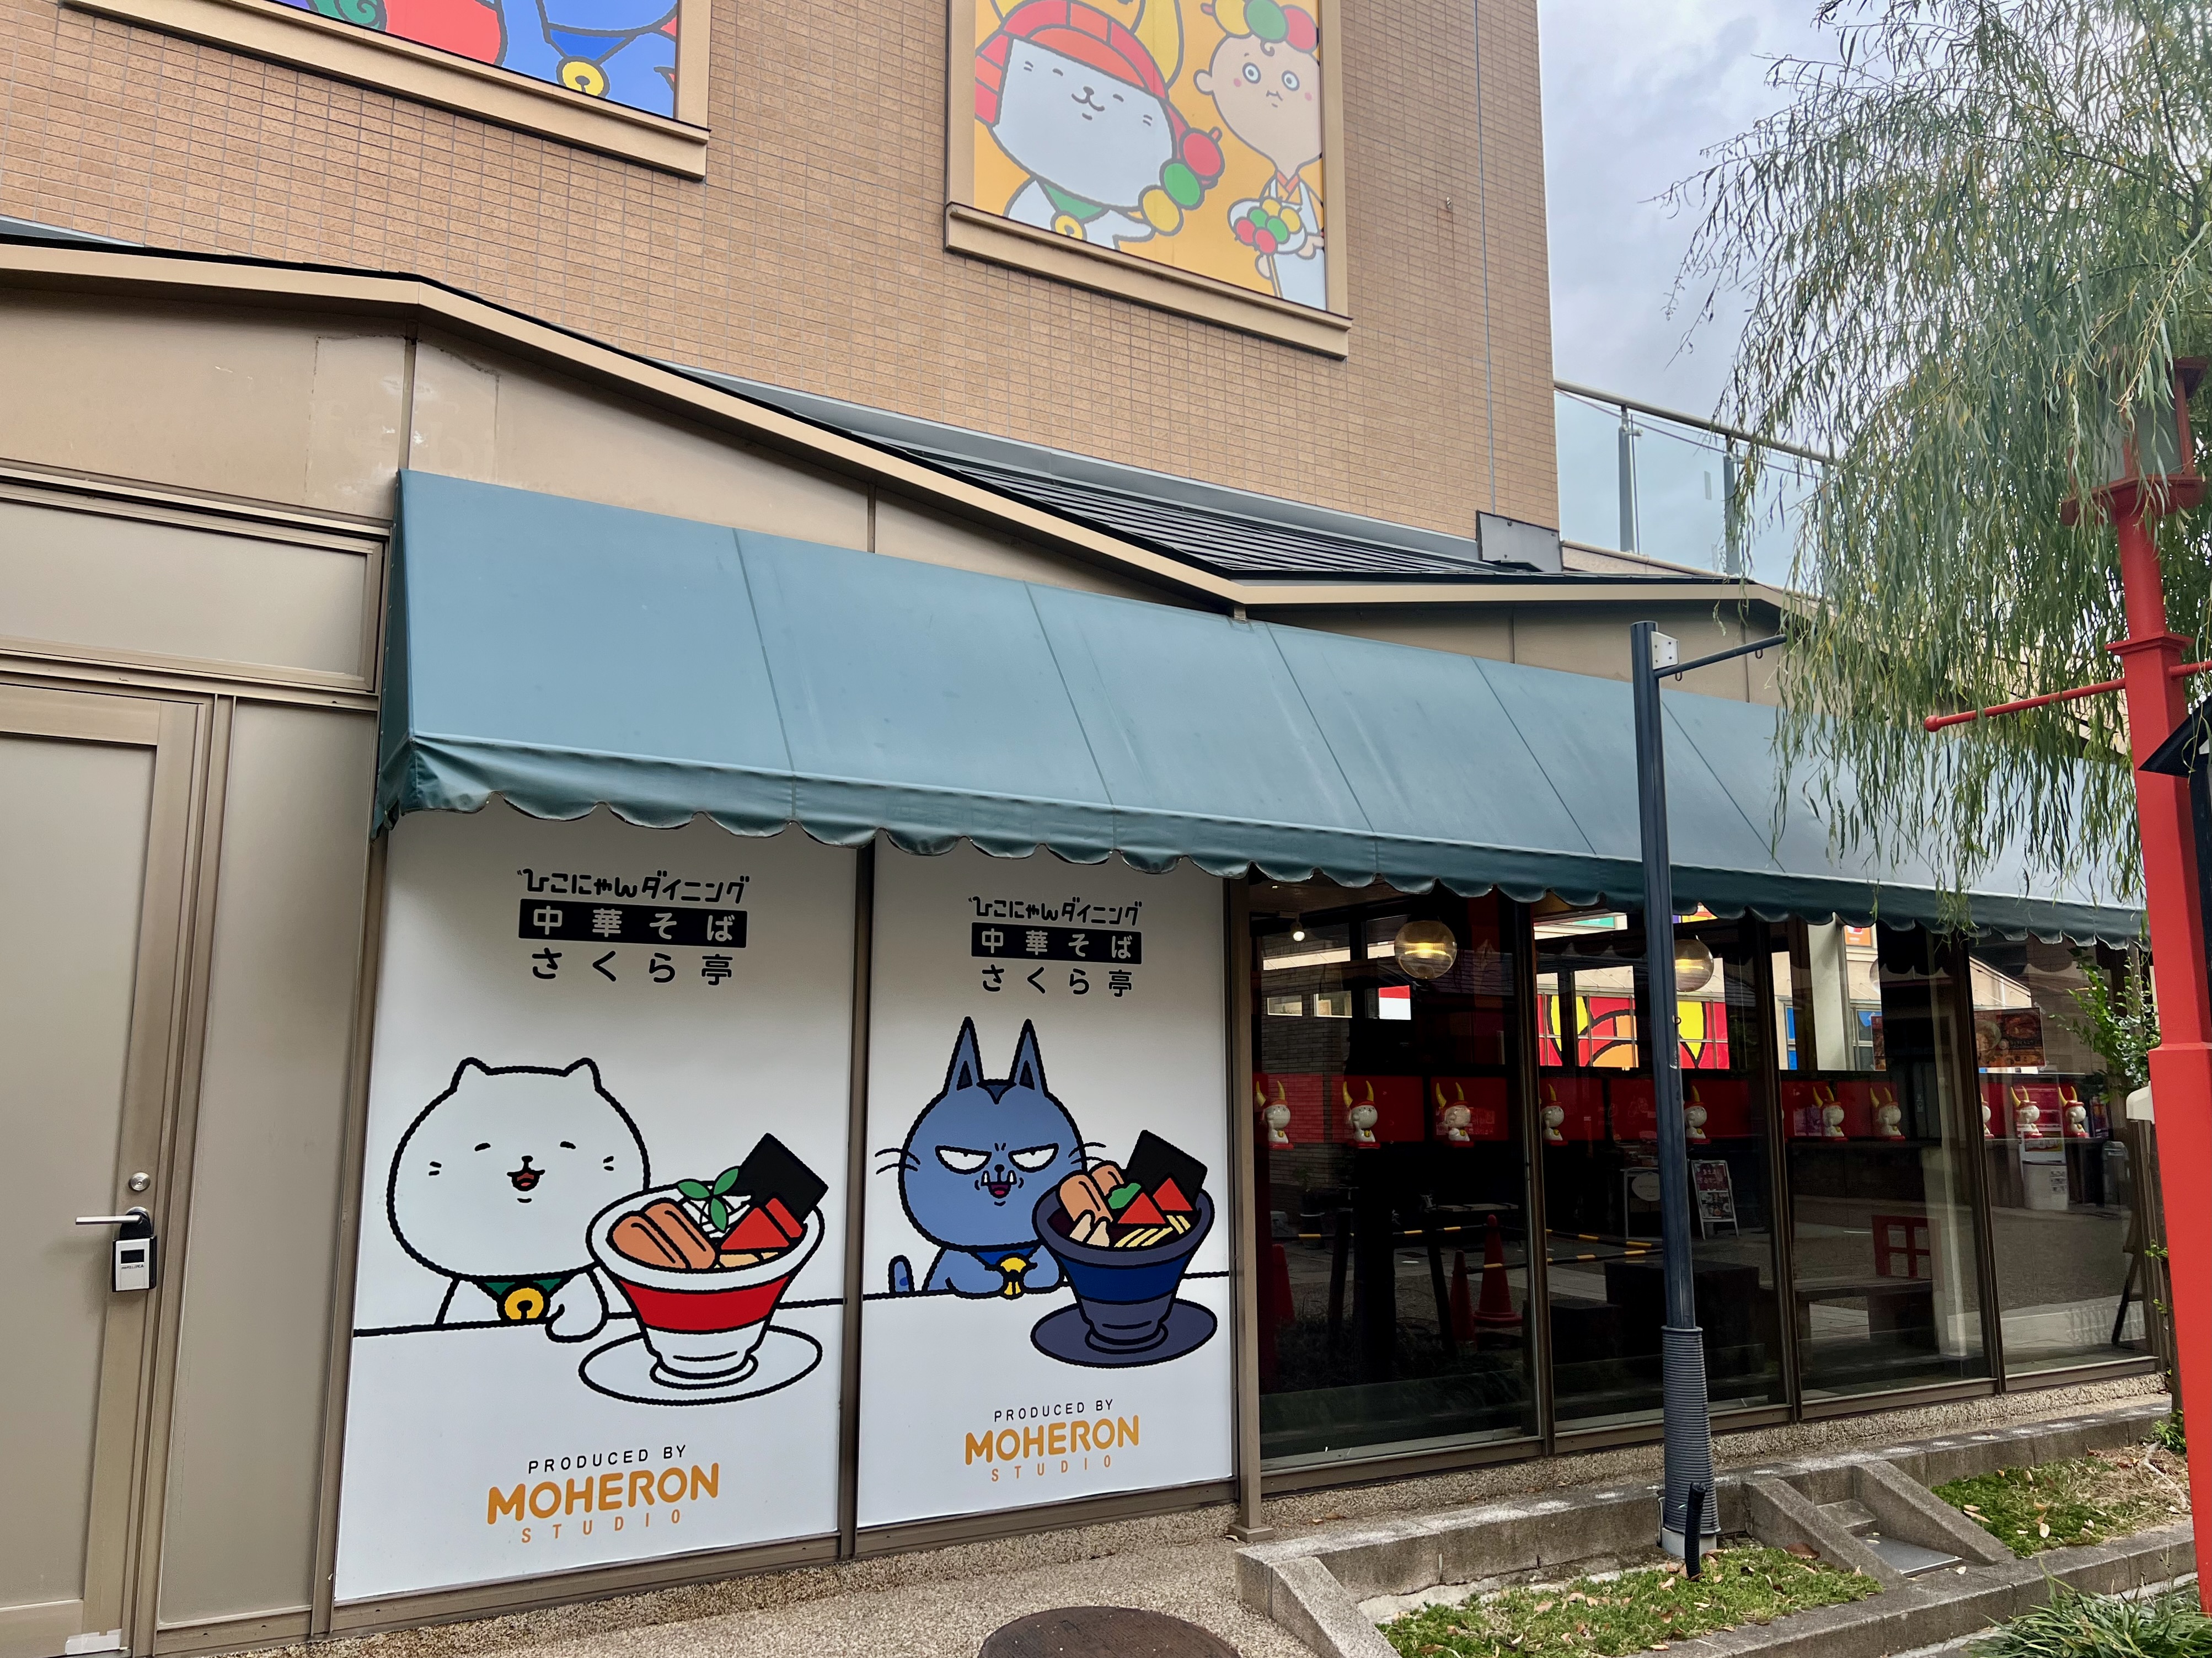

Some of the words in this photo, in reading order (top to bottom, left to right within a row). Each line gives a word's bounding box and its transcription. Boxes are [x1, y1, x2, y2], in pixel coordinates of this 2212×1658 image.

[517, 869, 750, 903] ひこにゃんダイニング
[533, 905, 735, 942] 中華そば
[968, 896, 1142, 926] ひこにゃんダイニング
[982, 928, 1133, 959] 中華そば
[532, 948, 733, 986] さくら亭
[982, 964, 1132, 997] さくら亭
[994, 1402, 1085, 1422] PRODUCED
[1096, 1399, 1113, 1411] BY
[965, 1415, 1139, 1466] MOHERON
[528, 1449, 649, 1474] PRODUCED
[663, 1445, 686, 1459] BY
[991, 1455, 1111, 1482] STUDIO
[487, 1463, 719, 1525] MOHERON
[521, 1509, 680, 1543] STUDIO
